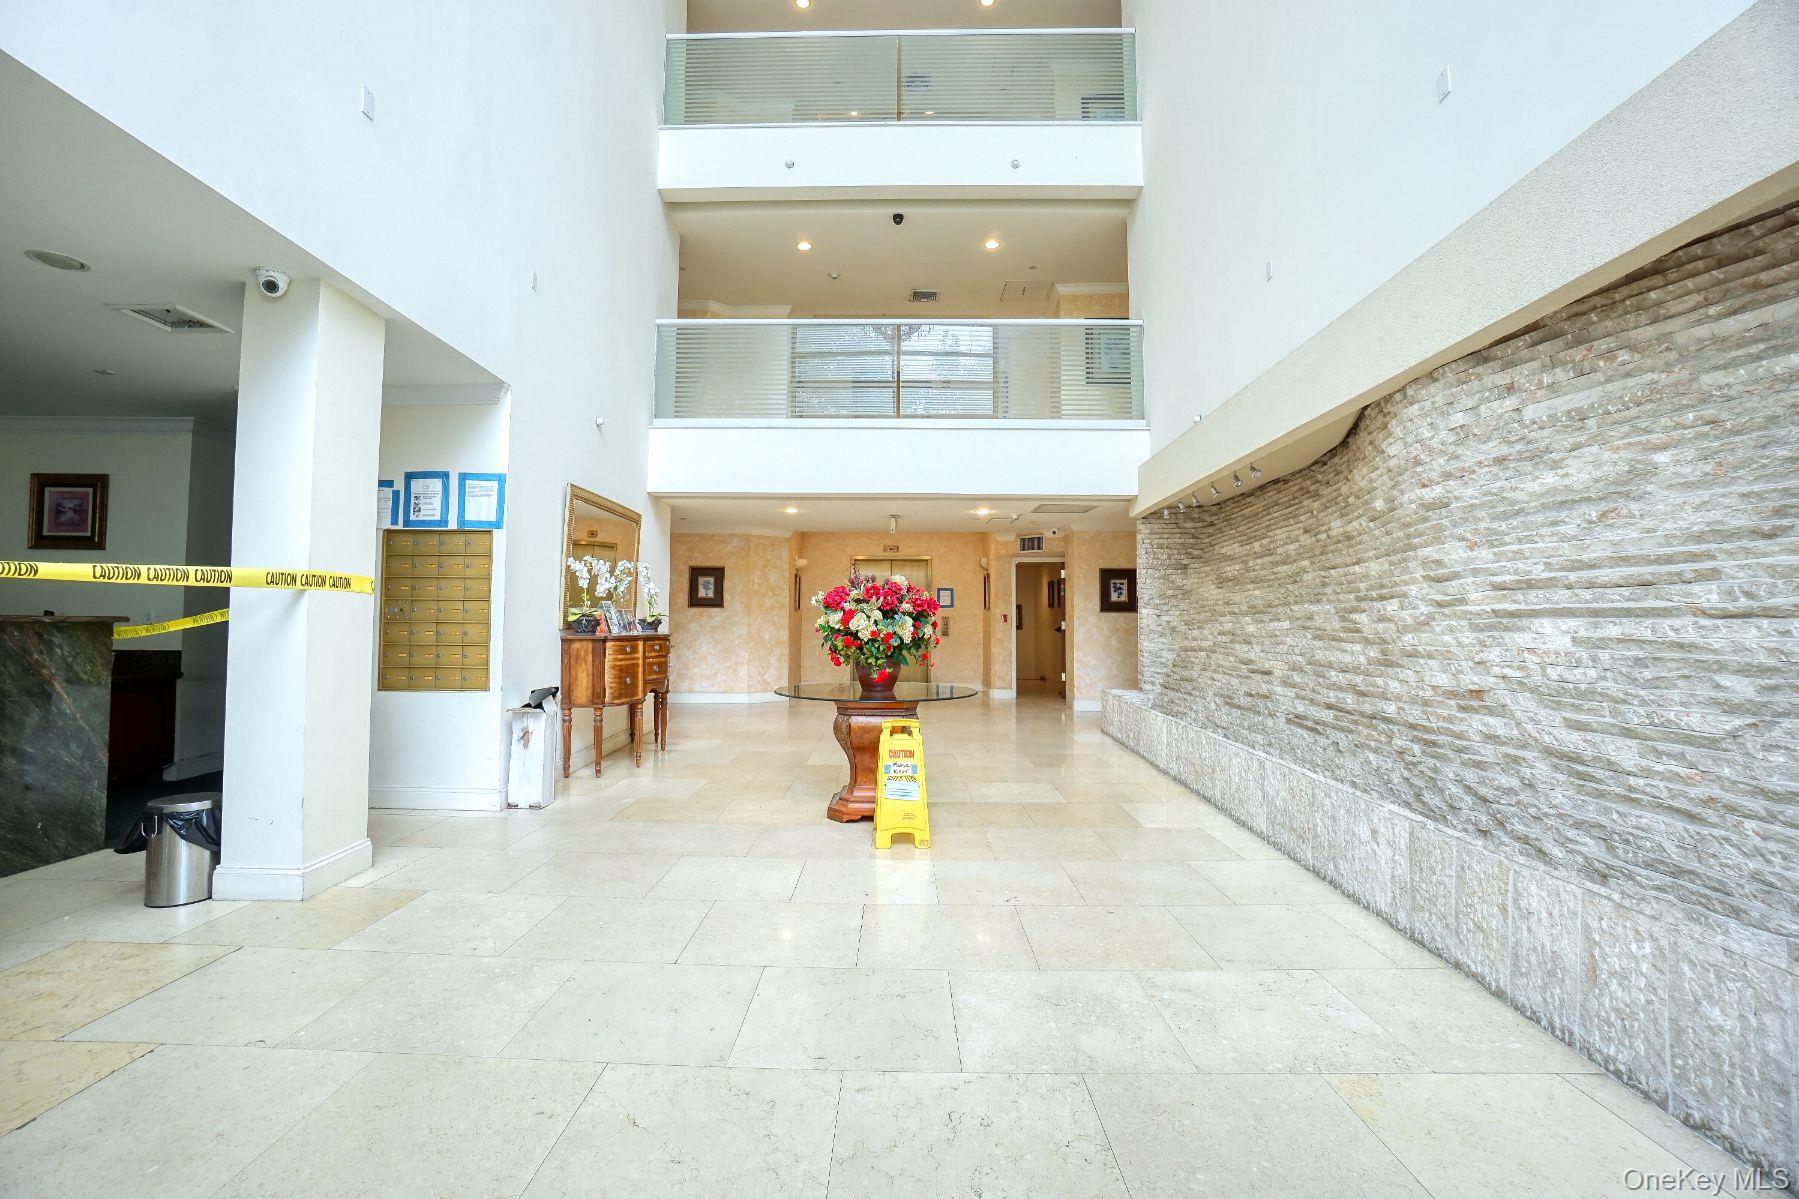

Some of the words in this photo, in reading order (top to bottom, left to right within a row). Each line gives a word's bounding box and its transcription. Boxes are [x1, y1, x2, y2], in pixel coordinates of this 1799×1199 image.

[92, 565, 141, 581] CAUTION
[146, 567, 189, 583] CAUTION
[194, 569, 232, 584] CAUTION
[265, 571, 297, 586] CAUTION
[300, 573, 326, 588] CAUTION
[328, 575, 352, 589] CAUTION
[888, 749, 915, 759] CAUTION
